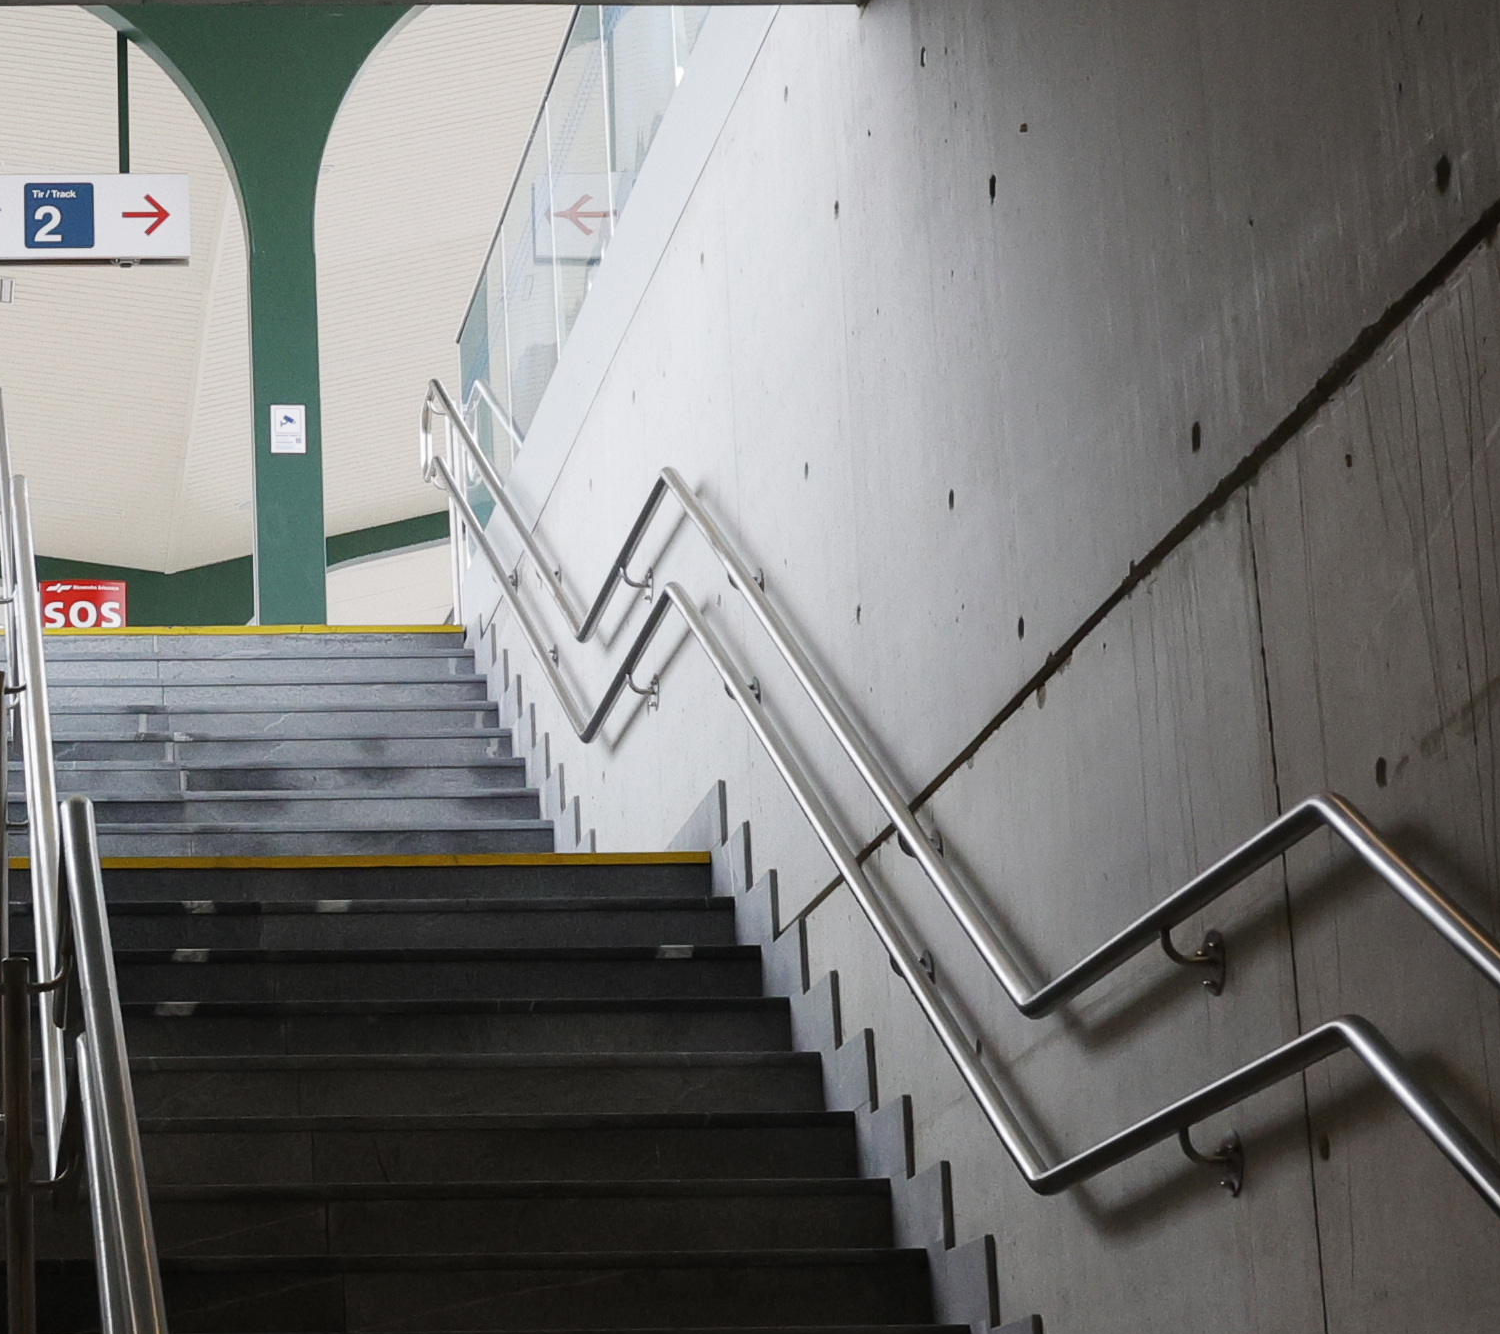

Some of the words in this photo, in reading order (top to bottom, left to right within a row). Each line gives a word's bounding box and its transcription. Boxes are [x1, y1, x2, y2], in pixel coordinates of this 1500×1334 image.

[32, 190, 44, 199] Tir
[50, 190, 76, 199] Track
[34, 205, 62, 242] 2
[44, 600, 122, 629] SOS
